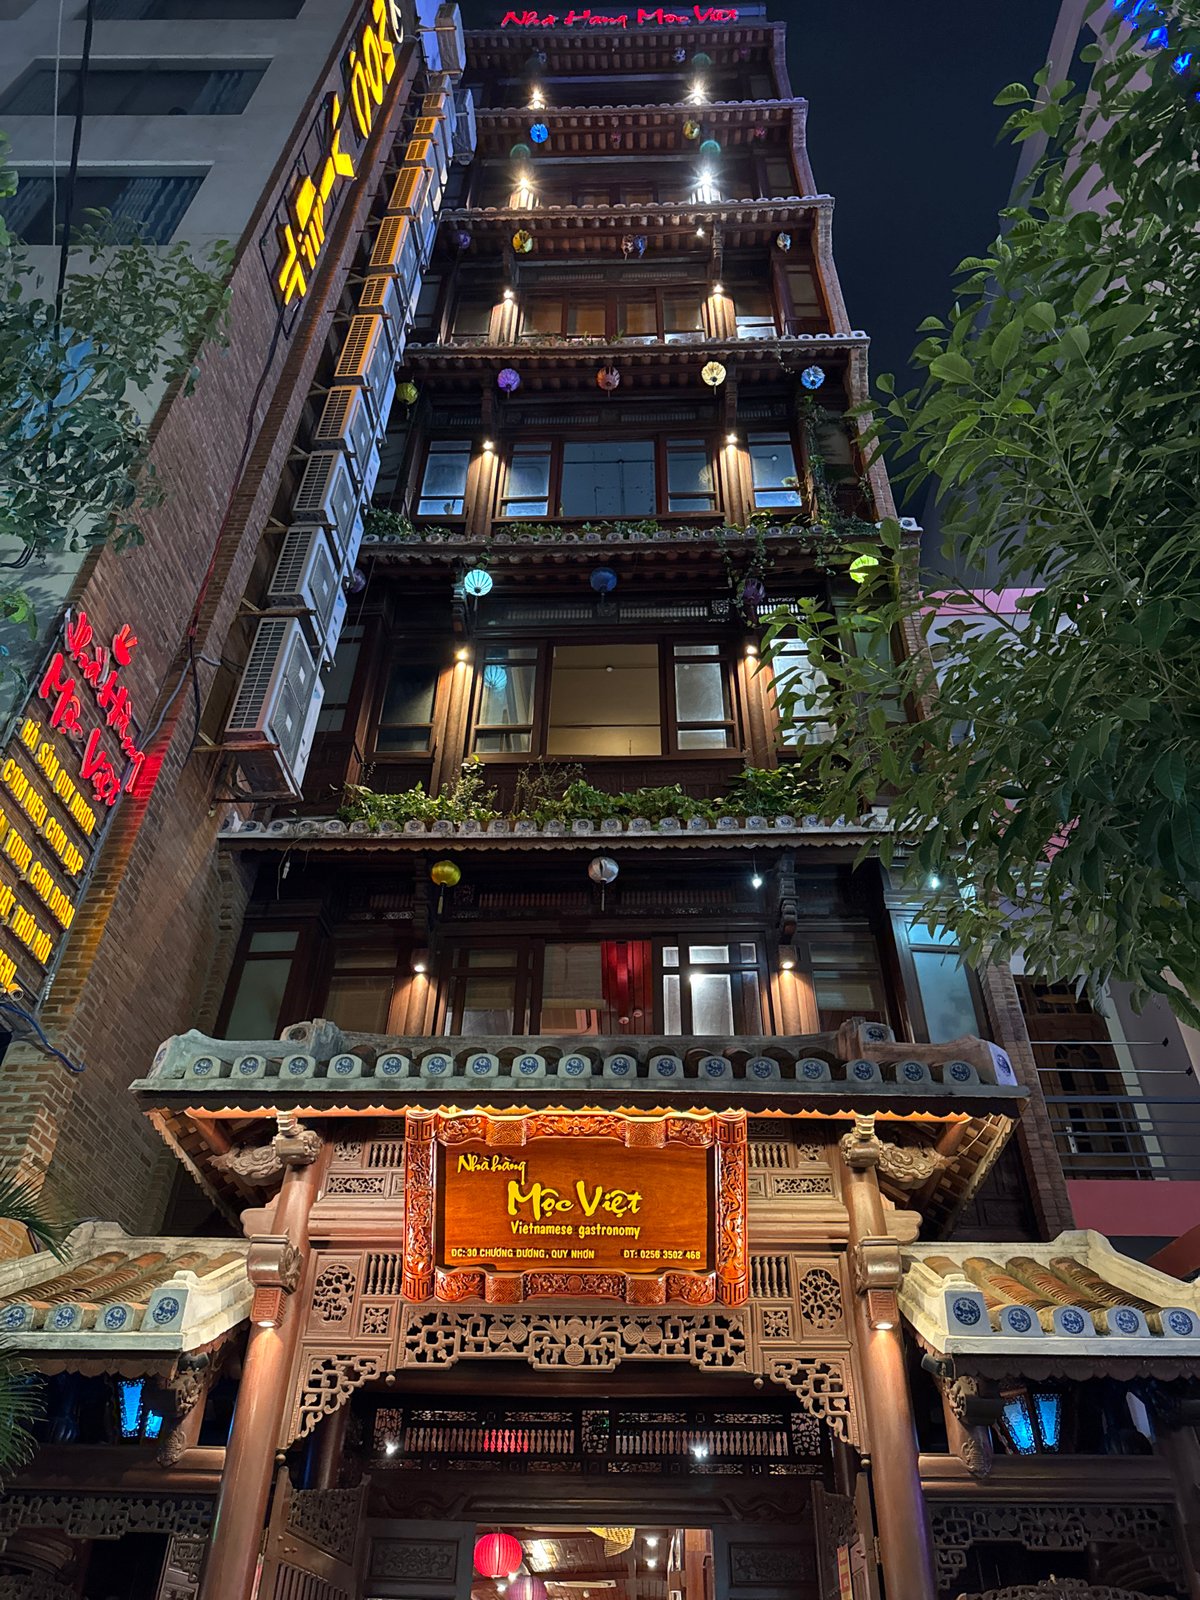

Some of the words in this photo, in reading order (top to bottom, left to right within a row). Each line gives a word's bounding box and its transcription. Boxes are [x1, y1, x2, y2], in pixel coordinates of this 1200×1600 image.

[54, 768, 77, 805] QUY
[457, 1153, 491, 1173] Nhà
[490, 1154, 526, 1186] hàng
[507, 1180, 574, 1221] Mộc
[575, 1180, 643, 1218] Việt
[511, 1220, 573, 1236] Vietnamese
[578, 1222, 641, 1240] gastronomy
[551, 1248, 569, 1260] QUY
[640, 1249, 661, 1260] 0256
[662, 1249, 684, 1261] 3502
[685, 1250, 701, 1261] 468
